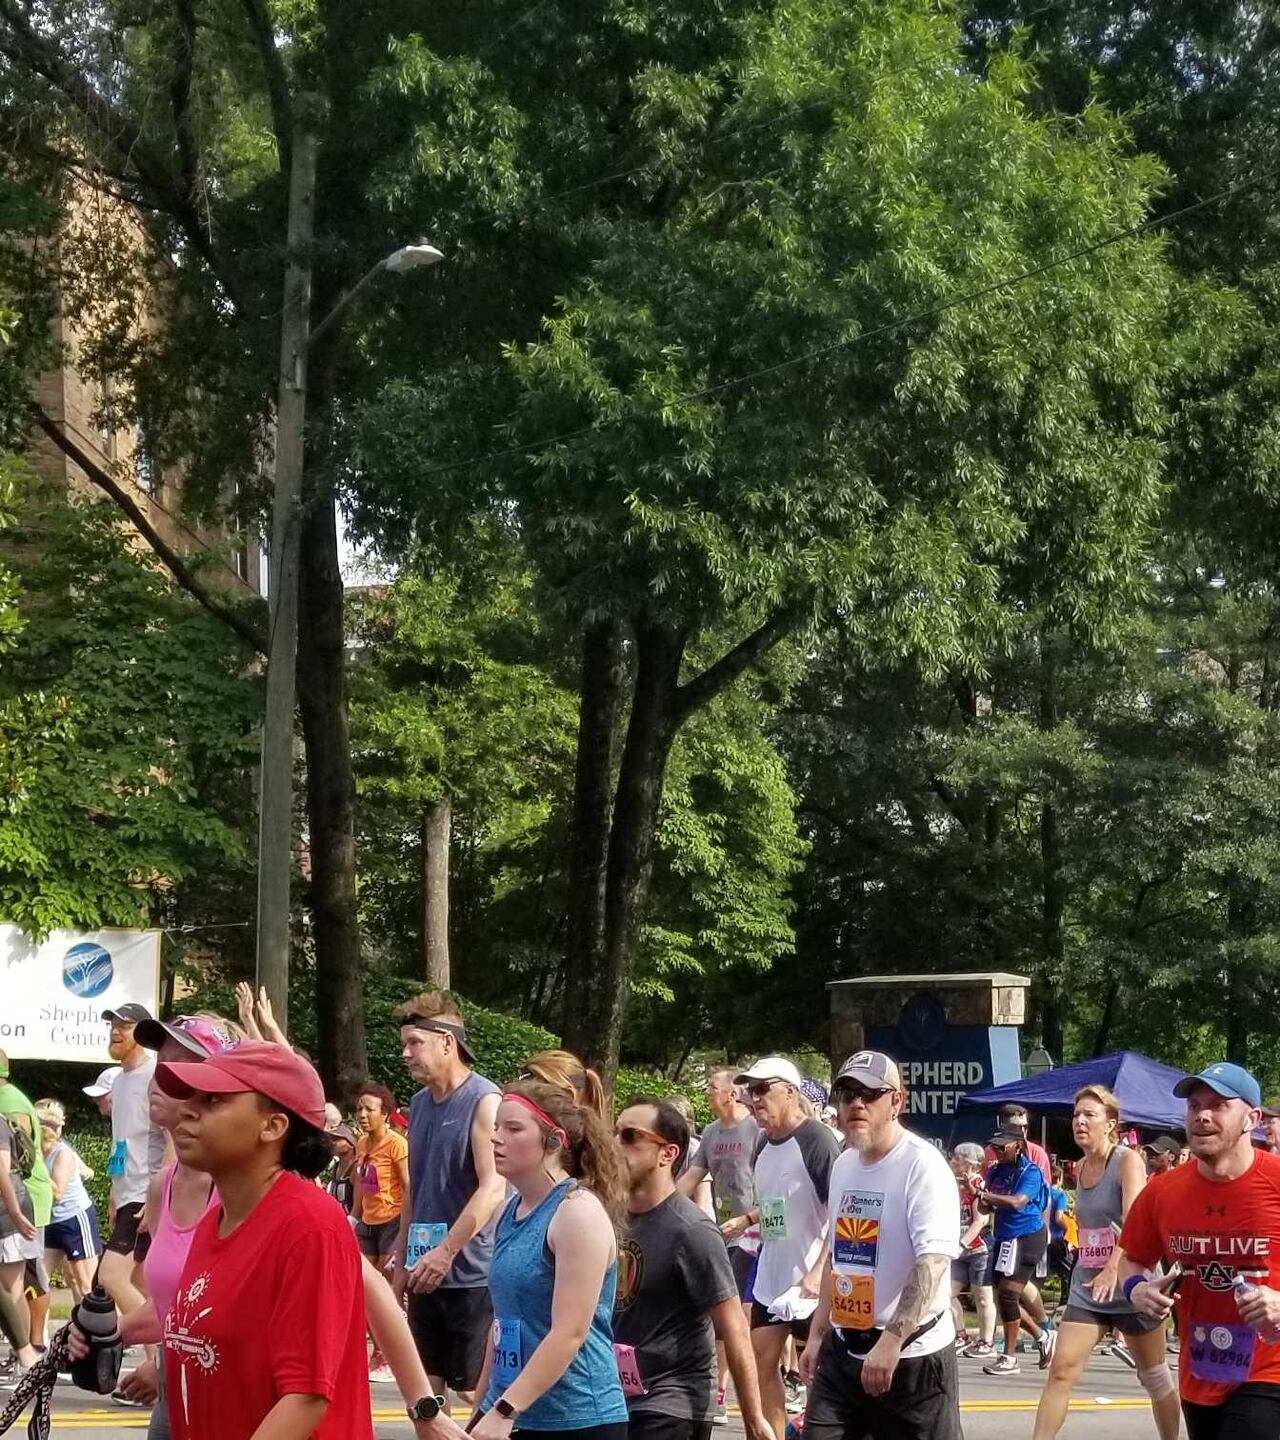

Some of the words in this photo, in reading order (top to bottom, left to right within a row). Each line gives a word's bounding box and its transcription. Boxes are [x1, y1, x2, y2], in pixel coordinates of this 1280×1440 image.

[38, 1003, 103, 1025] Sheph
[50, 1027, 108, 1048] Cente
[898, 1061, 984, 1086] EPHERD
[900, 1090, 967, 1115] ENTE
[1085, 1245, 1114, 1258] 56807
[1215, 1237, 1270, 1255] LIVE
[834, 1296, 872, 1315] 54213
